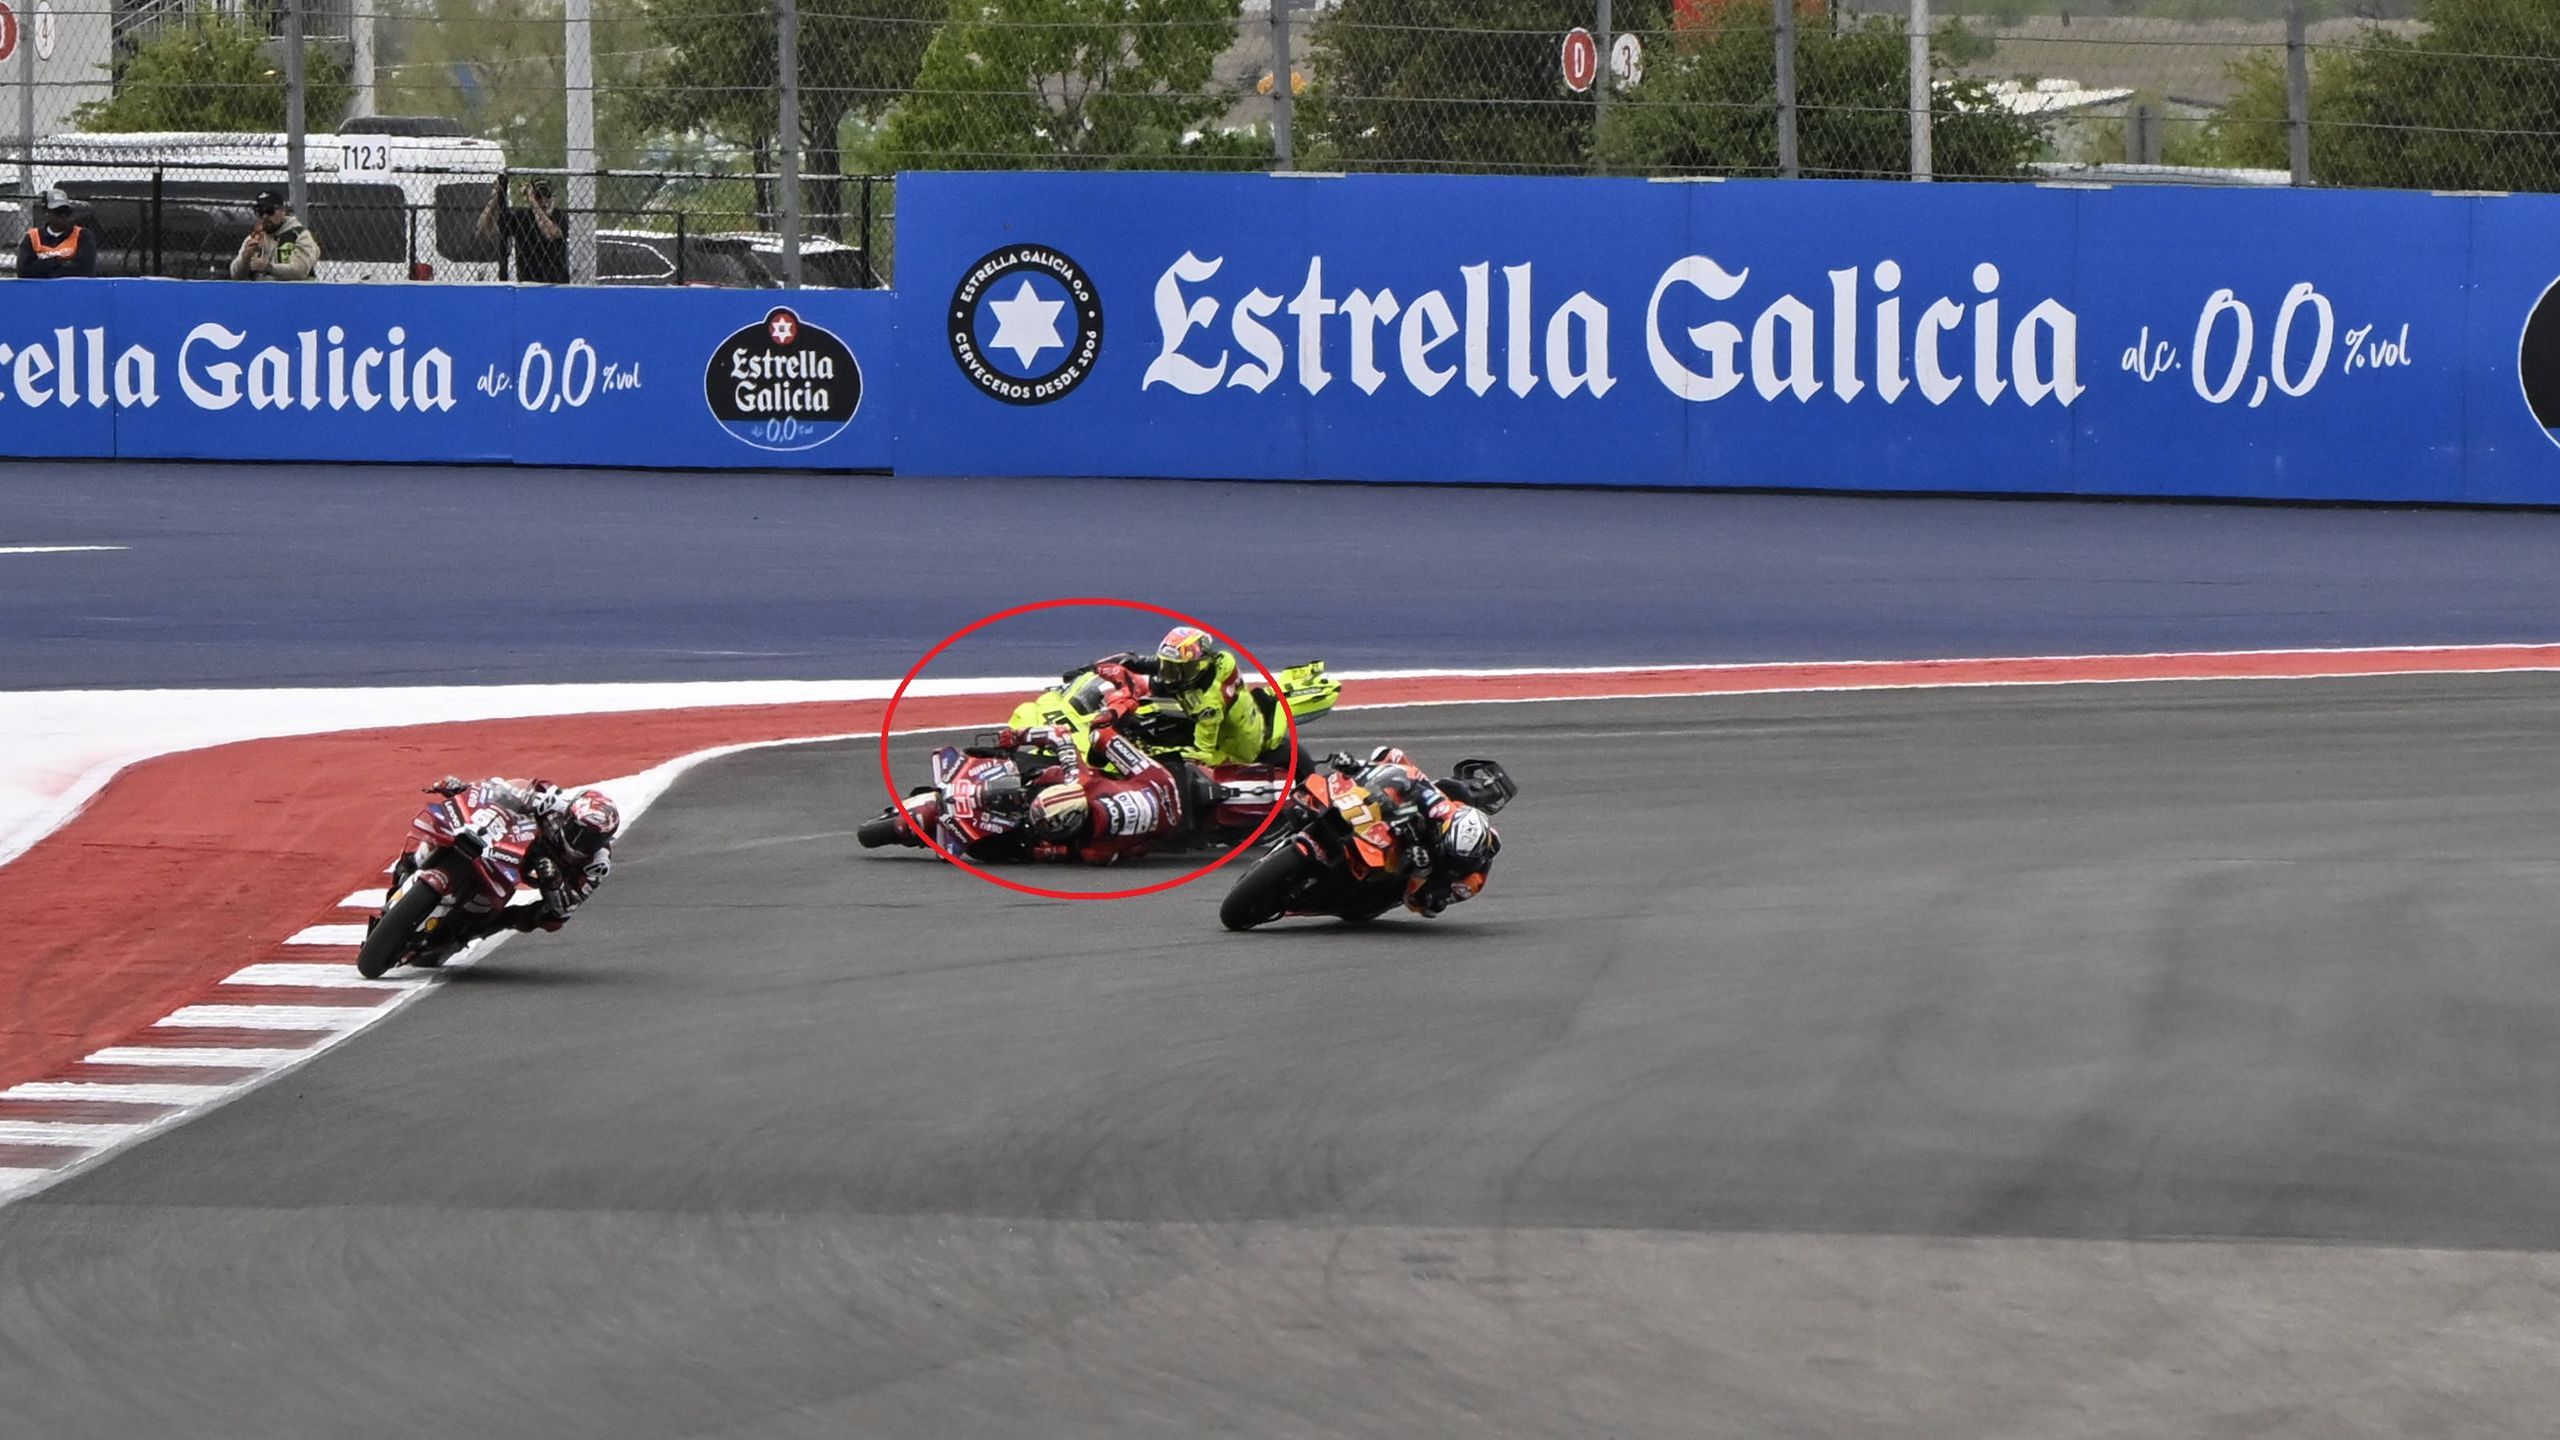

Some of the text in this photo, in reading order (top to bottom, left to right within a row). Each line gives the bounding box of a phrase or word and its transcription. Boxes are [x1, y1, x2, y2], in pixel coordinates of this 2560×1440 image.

[1622, 45, 1631, 79] 3
[342, 146, 386, 170] T12.3
[960, 253, 1018, 303] ESTRELLA
[1020, 251, 1074, 281] GALICIA
[1142, 250, 1617, 399] Estrella
[1646, 255, 2086, 407] Galicia
[2121, 326, 2181, 382] alc.
[2192, 282, 2334, 408] 0,0
[178, 322, 457, 411] Galicia
[477, 364, 513, 397] alc.
[518, 338, 597, 413] 0,0
[731, 348, 834, 412] Estrella Galicia
[955, 331, 1097, 399] CERVECEROS DESDE 1906
[444, 800, 461, 828] Lenovo
[490, 848, 520, 865] Lenovo
